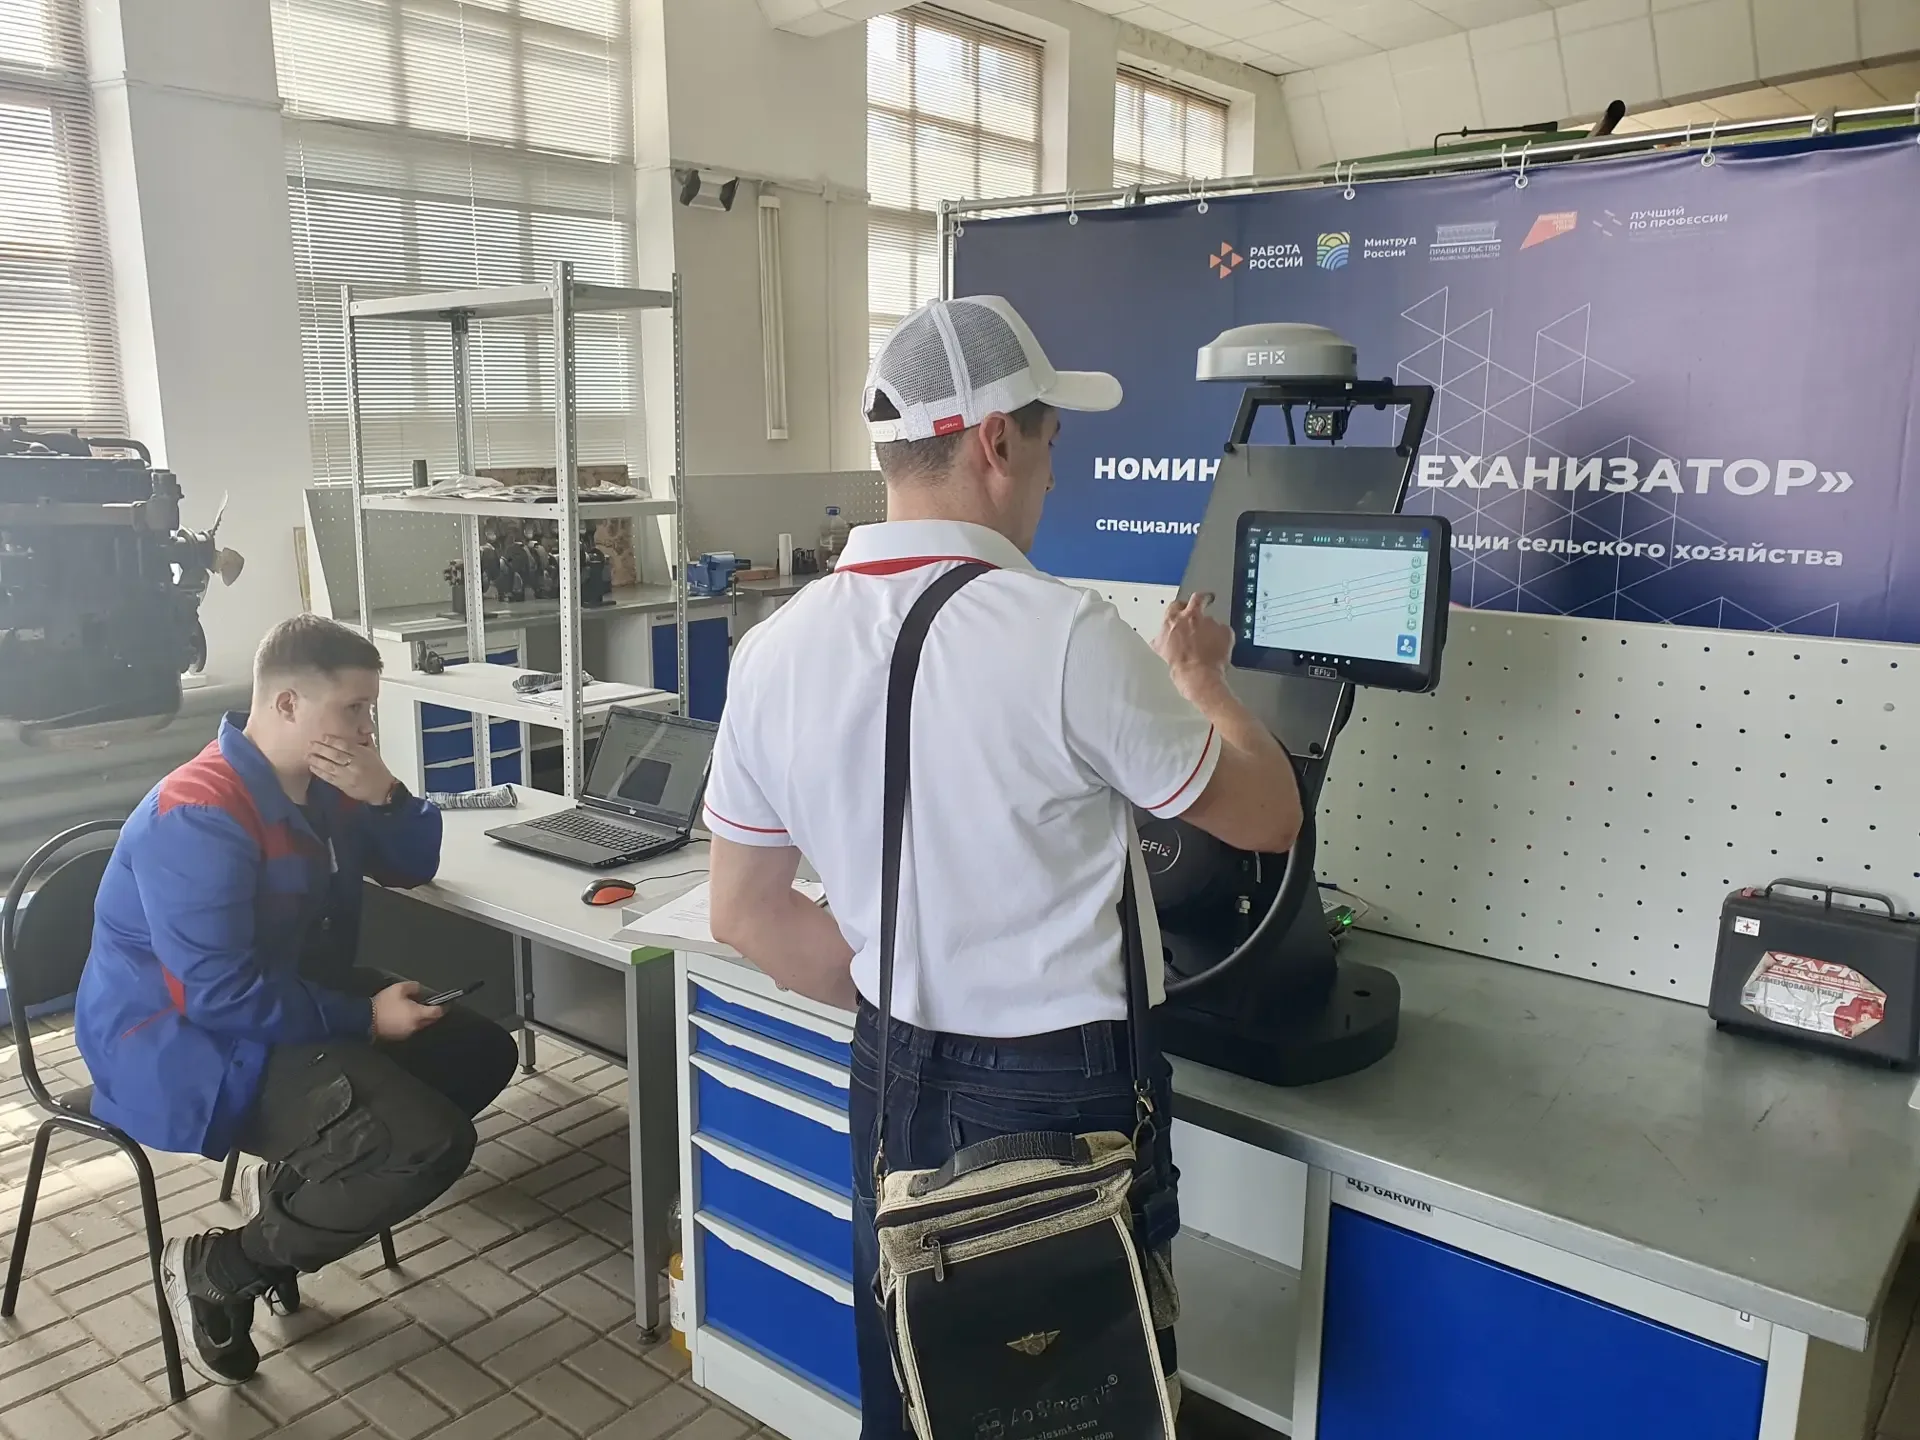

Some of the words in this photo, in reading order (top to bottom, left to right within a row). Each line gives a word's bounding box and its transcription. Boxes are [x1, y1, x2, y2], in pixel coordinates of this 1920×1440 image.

[1630, 205, 1685, 220] ЛУЧШИЙ
[1629, 221, 1647, 230] ПО
[1650, 213, 1728, 228] ПРОФЕССИИ
[1250, 243, 1300, 258] РАБОТА
[1364, 236, 1417, 250] Минтруд
[1429, 244, 1501, 255] ПРАВИТЕЛЬСТВО
[1363, 249, 1406, 259] России
[1249, 256, 1304, 270] РОССИИ
[1247, 350, 1286, 366] EFIX
[1411, 455, 1854, 496] ЕХАНИЗАТОР»
[1516, 537, 1666, 558] сельского
[1674, 542, 1844, 566] хозяйства
[1140, 839, 1171, 857] EFIX
